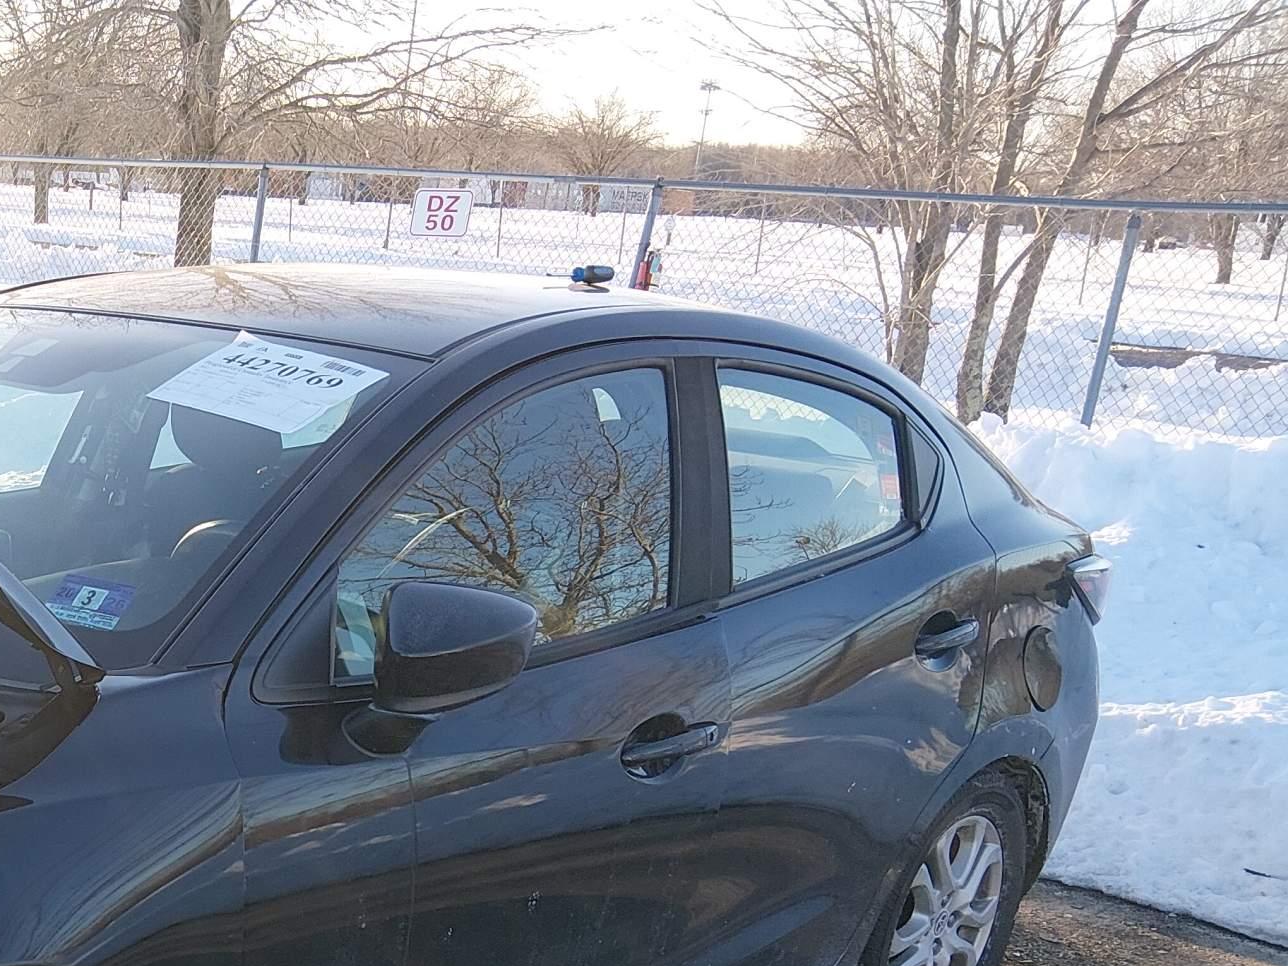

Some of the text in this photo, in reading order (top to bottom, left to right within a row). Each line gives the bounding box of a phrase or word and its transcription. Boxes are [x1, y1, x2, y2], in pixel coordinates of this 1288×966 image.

[426, 195, 462, 213] DZ
[424, 214, 455, 232] 50
[222, 352, 344, 389] 44270769
[81, 590, 97, 606] 3
